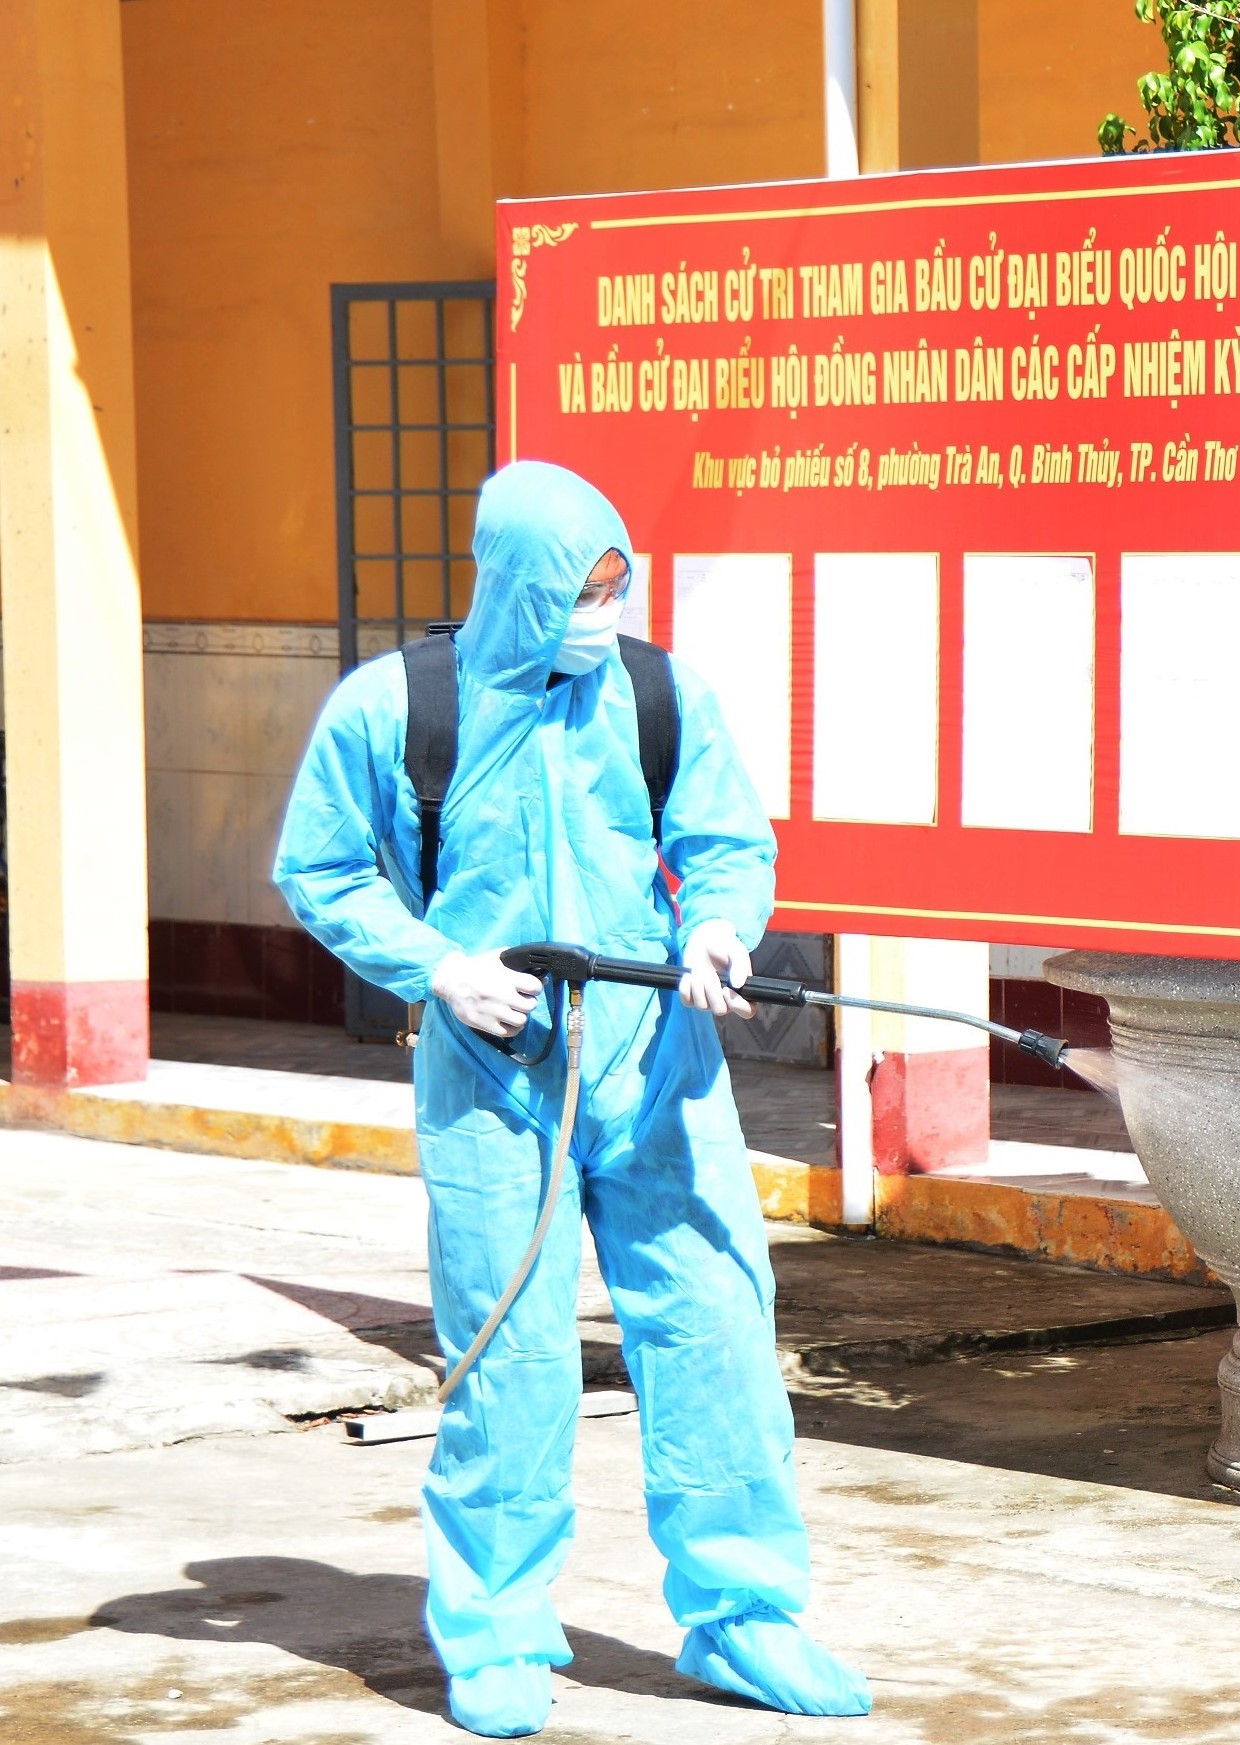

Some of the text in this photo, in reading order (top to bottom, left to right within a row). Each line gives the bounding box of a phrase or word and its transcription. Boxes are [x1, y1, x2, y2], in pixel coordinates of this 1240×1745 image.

[598, 274, 655, 326] DANH
[662, 261, 718, 324] SÁCH
[725, 247, 756, 321] CỬ
[759, 268, 793, 319] TRI
[800, 263, 863, 318] THAM
[870, 260, 908, 314] GIA
[916, 239, 961, 311] BẦU
[970, 232, 1004, 310] CỬ
[1008, 253, 1047, 320] ĐẠI
[1056, 227, 1111, 306] BIỂU
[1120, 226, 1186, 310] QUỐC
[1195, 231, 1236, 311] HỘI
[559, 352, 586, 413] VÀ
[592, 344, 633, 412] BẦU
[639, 338, 670, 411] CỬ
[673, 359, 709, 421] ĐẠI
[716, 336, 764, 408] BIỂU
[772, 344, 808, 419] HỘI
[814, 336, 876, 406] ĐỒNG
[884, 338, 947, 403] NHÂN
[956, 337, 1003, 401] DÂN
[1012, 335, 1058, 400] CÁC
[1068, 324, 1115, 399] CẤP
[1124, 329, 1205, 408] NHIỆM
[693, 433, 1238, 496] Khu vực bỏ phiếu số 8, phường Trà An, Q. Bình Thủy, TP. Cần Thơ
